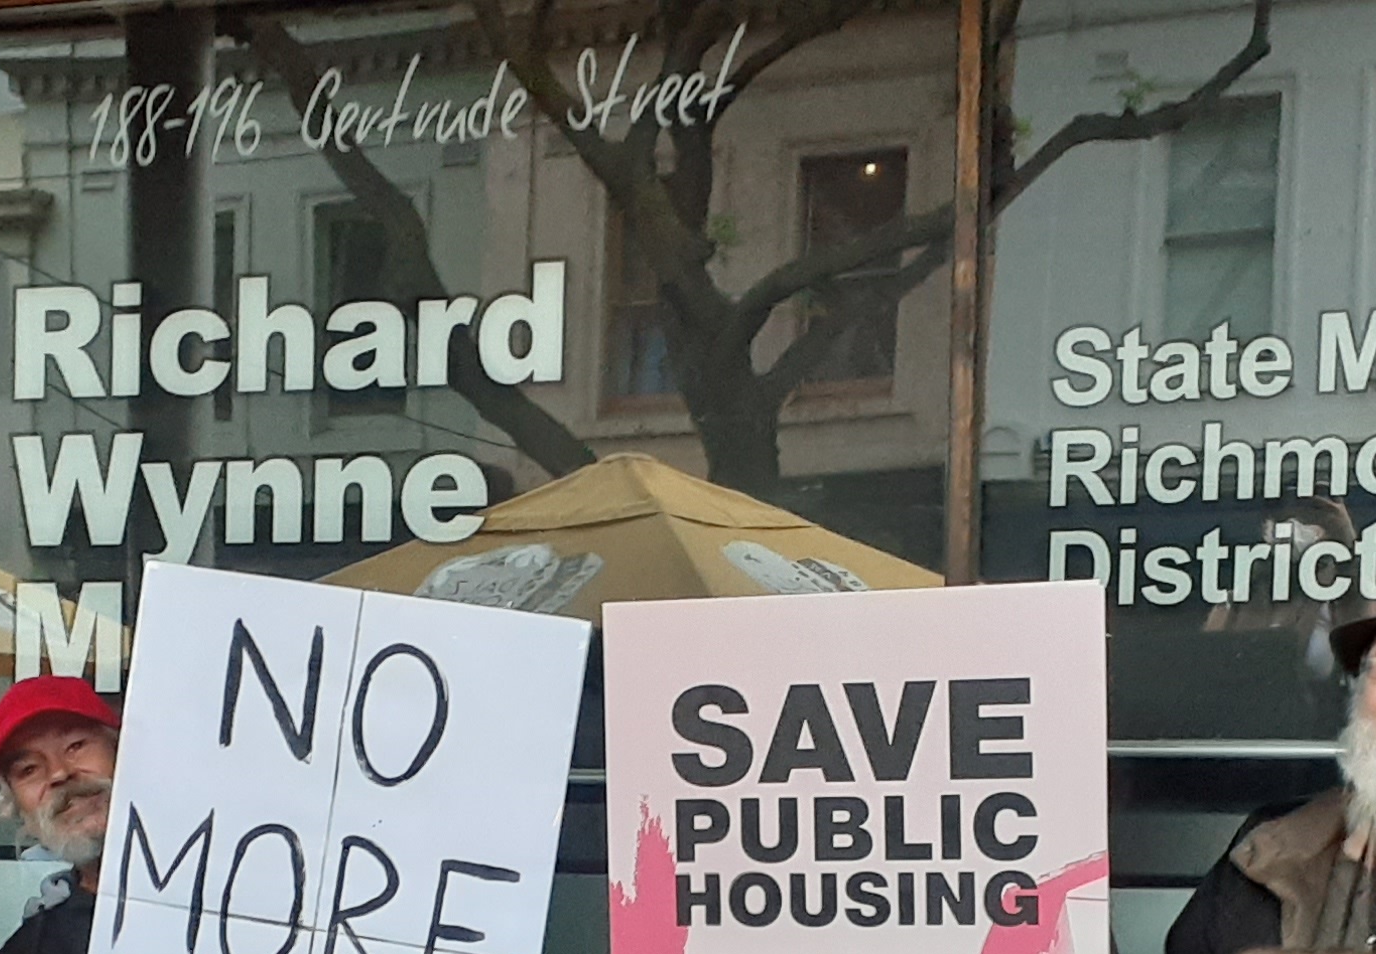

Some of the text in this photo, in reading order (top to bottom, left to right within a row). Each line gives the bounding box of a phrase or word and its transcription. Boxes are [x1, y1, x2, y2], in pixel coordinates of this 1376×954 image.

[89, 22, 746, 167] 188-196 Gertrude Street
[13, 261, 567, 399] Richard
[1052, 317, 1293, 409] State
[11, 430, 490, 564] Wynne
[218, 617, 450, 788] NO
[670, 677, 1035, 788] SAVE
[675, 792, 1039, 863] PUBLIC
[674, 870, 1040, 928] HOUSING
